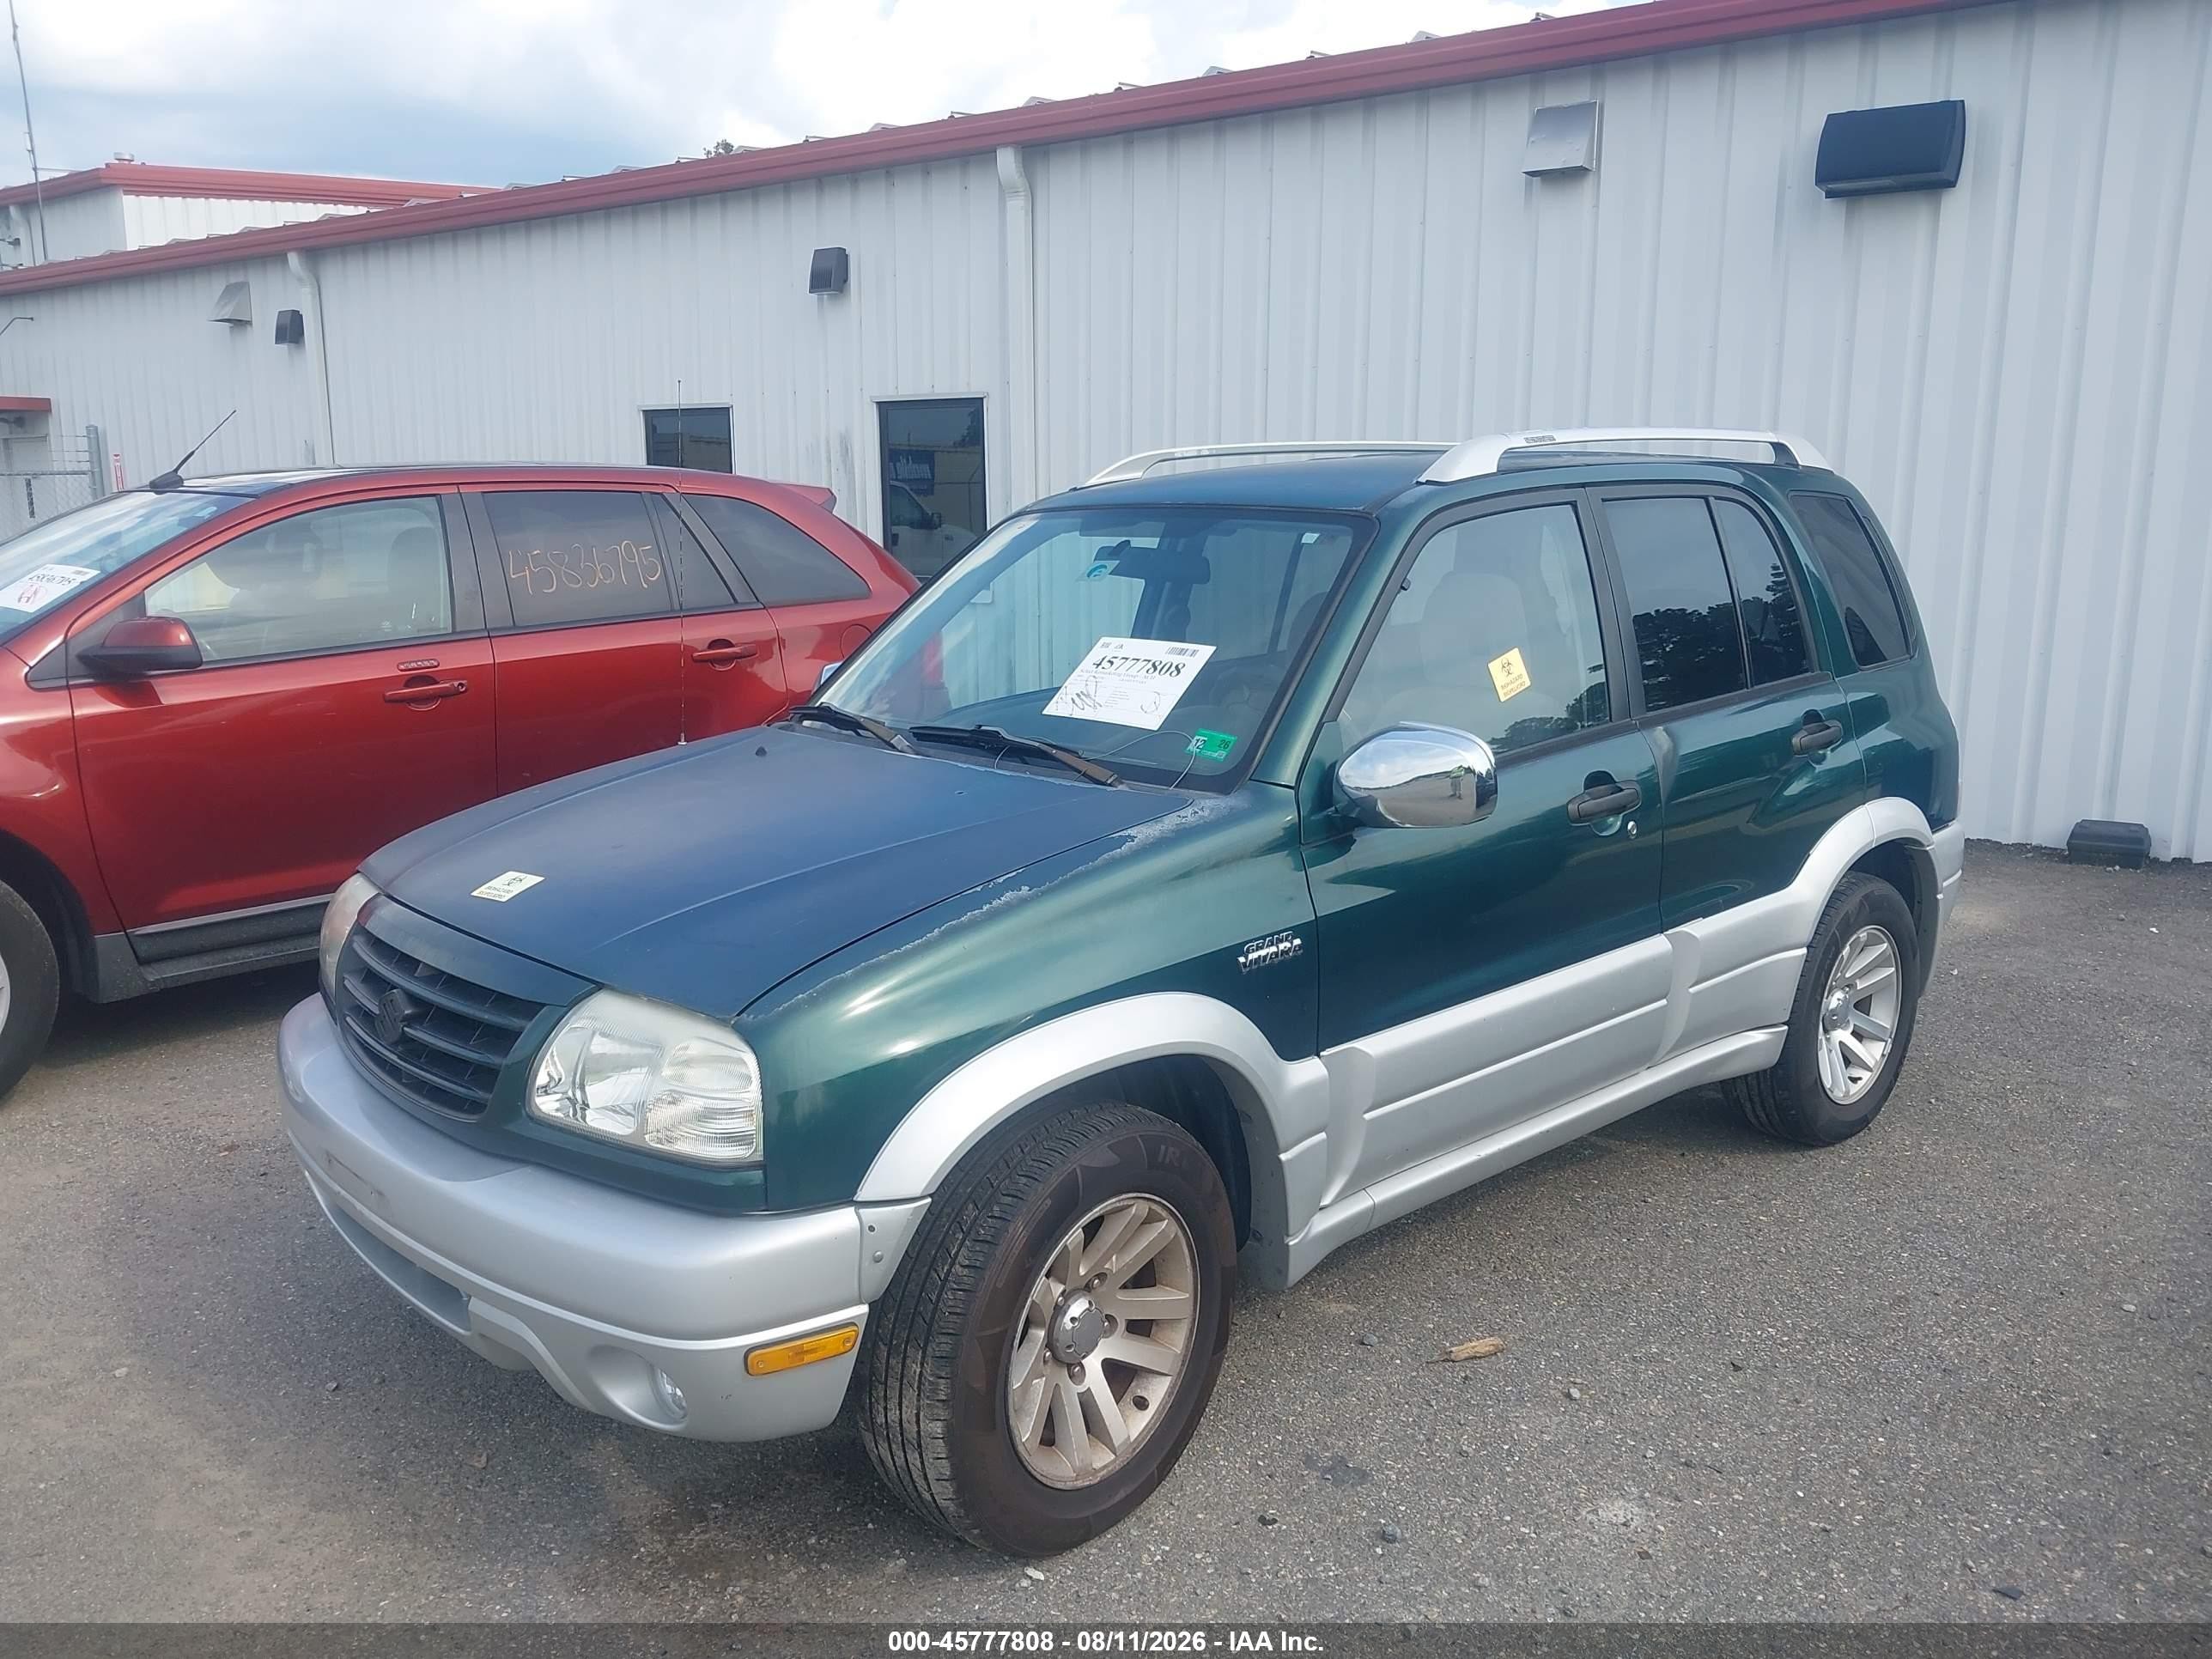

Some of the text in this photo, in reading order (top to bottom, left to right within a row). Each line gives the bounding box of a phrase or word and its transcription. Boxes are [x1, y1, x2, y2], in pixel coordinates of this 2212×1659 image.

[508, 540, 661, 595] 45836795
[1092, 654, 1186, 678] 45777808
[1218, 738, 1231, 750] 26
[1244, 931, 1293, 954] GRAND
[1237, 939, 1303, 974] VITARA
